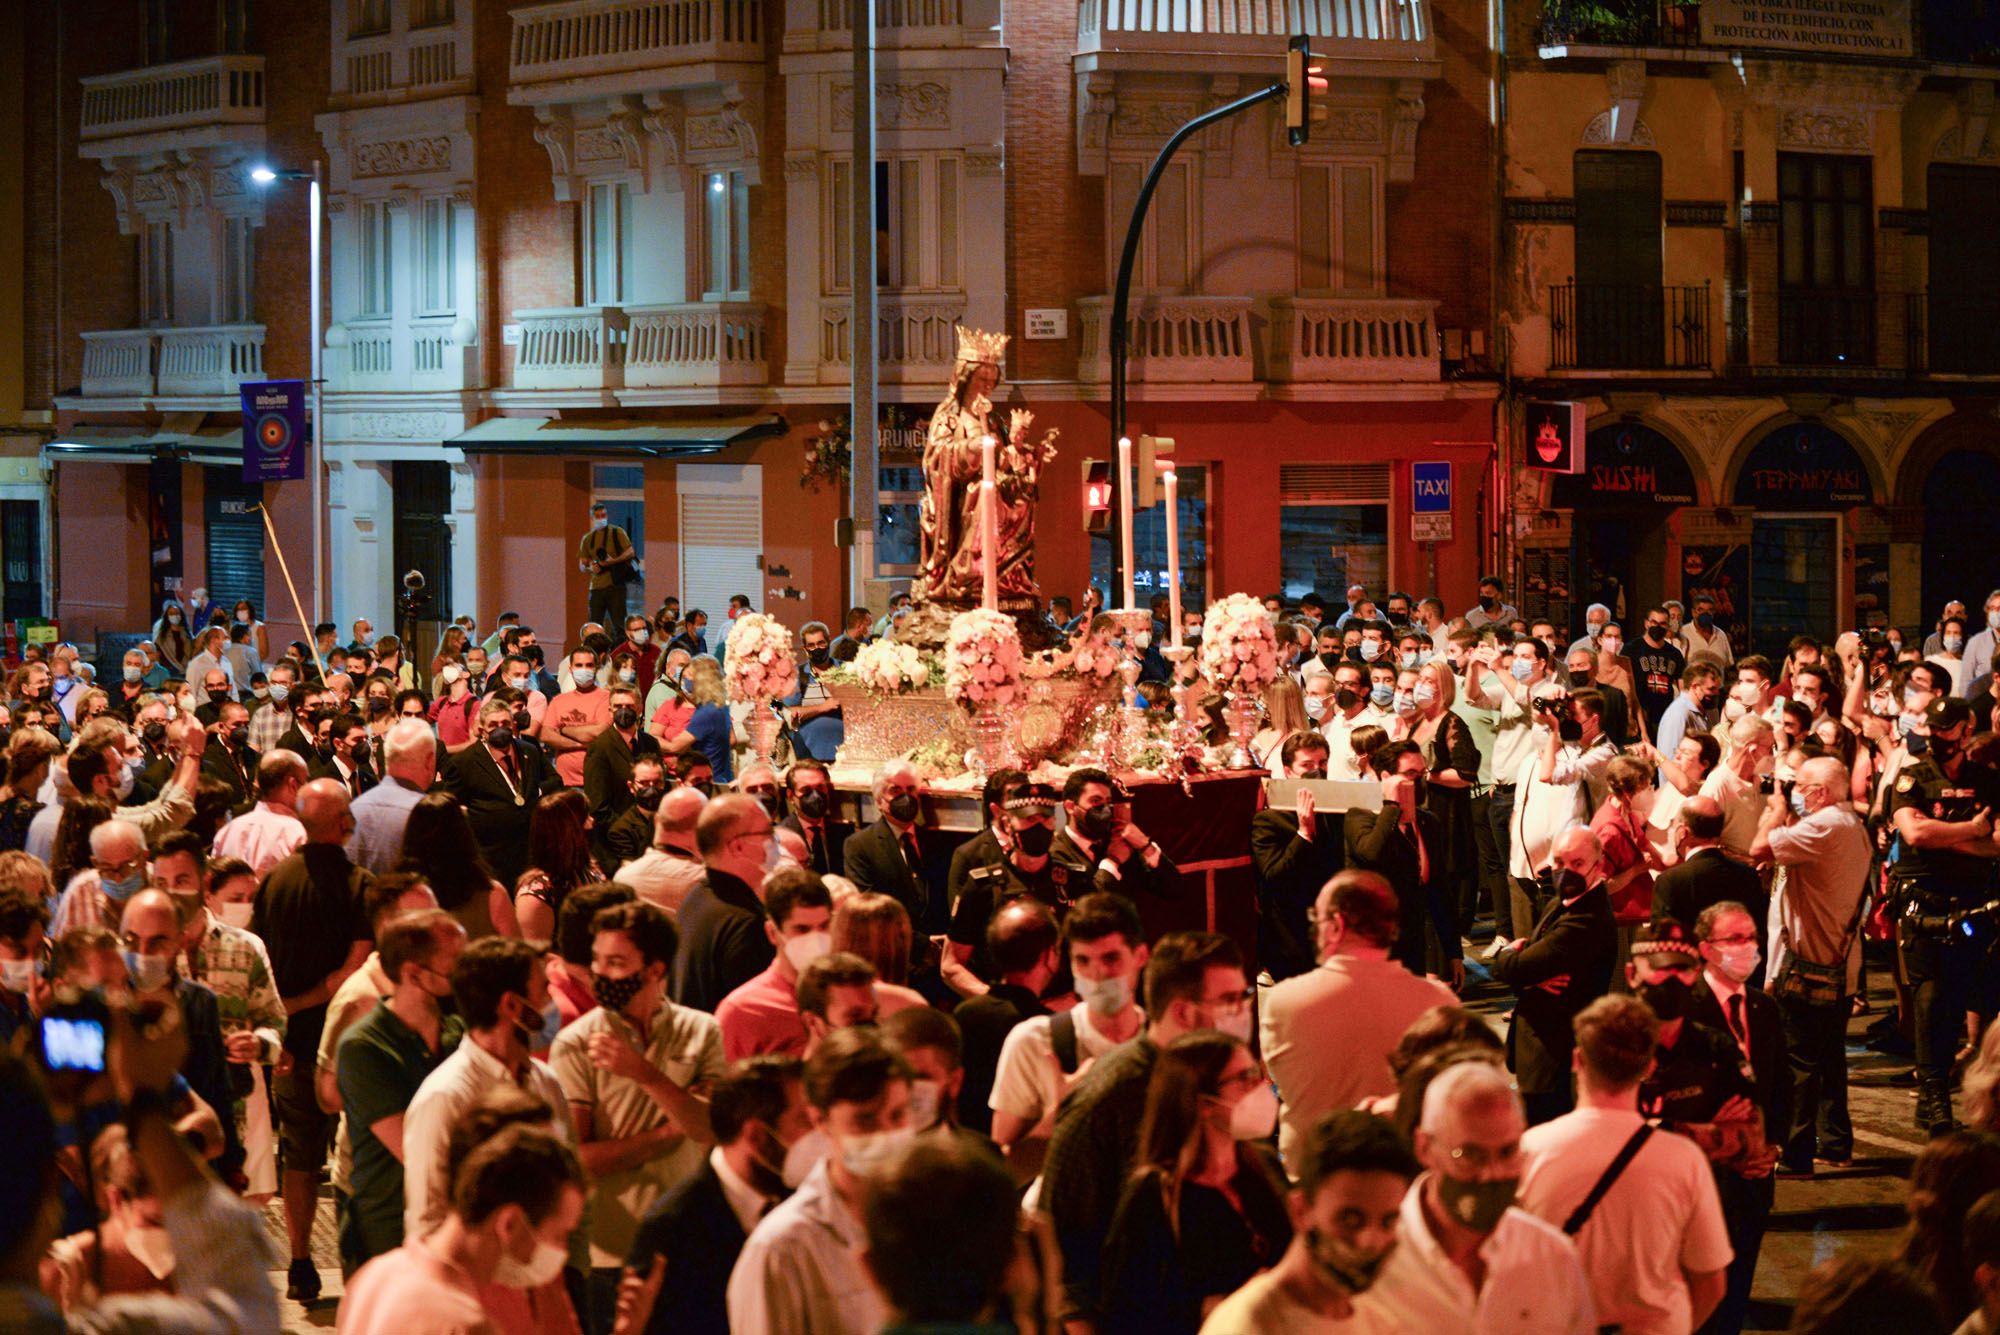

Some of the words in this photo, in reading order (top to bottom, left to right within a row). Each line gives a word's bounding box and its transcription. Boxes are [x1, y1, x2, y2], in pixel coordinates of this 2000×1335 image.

[1839, 2, 1885, 16] ENCIMA
[1743, 10, 1758, 22] DE
[1762, 11, 1790, 25] ESTE
[1849, 18, 1873, 32] CON
[1713, 23, 1788, 41] PROTECCIÓN
[1416, 480, 1449, 496] TAXI
[1592, 465, 1656, 493] SUSHI
[1752, 468, 1862, 491] TEPPANYAKI
[1640, 655, 1676, 675] OSLO
